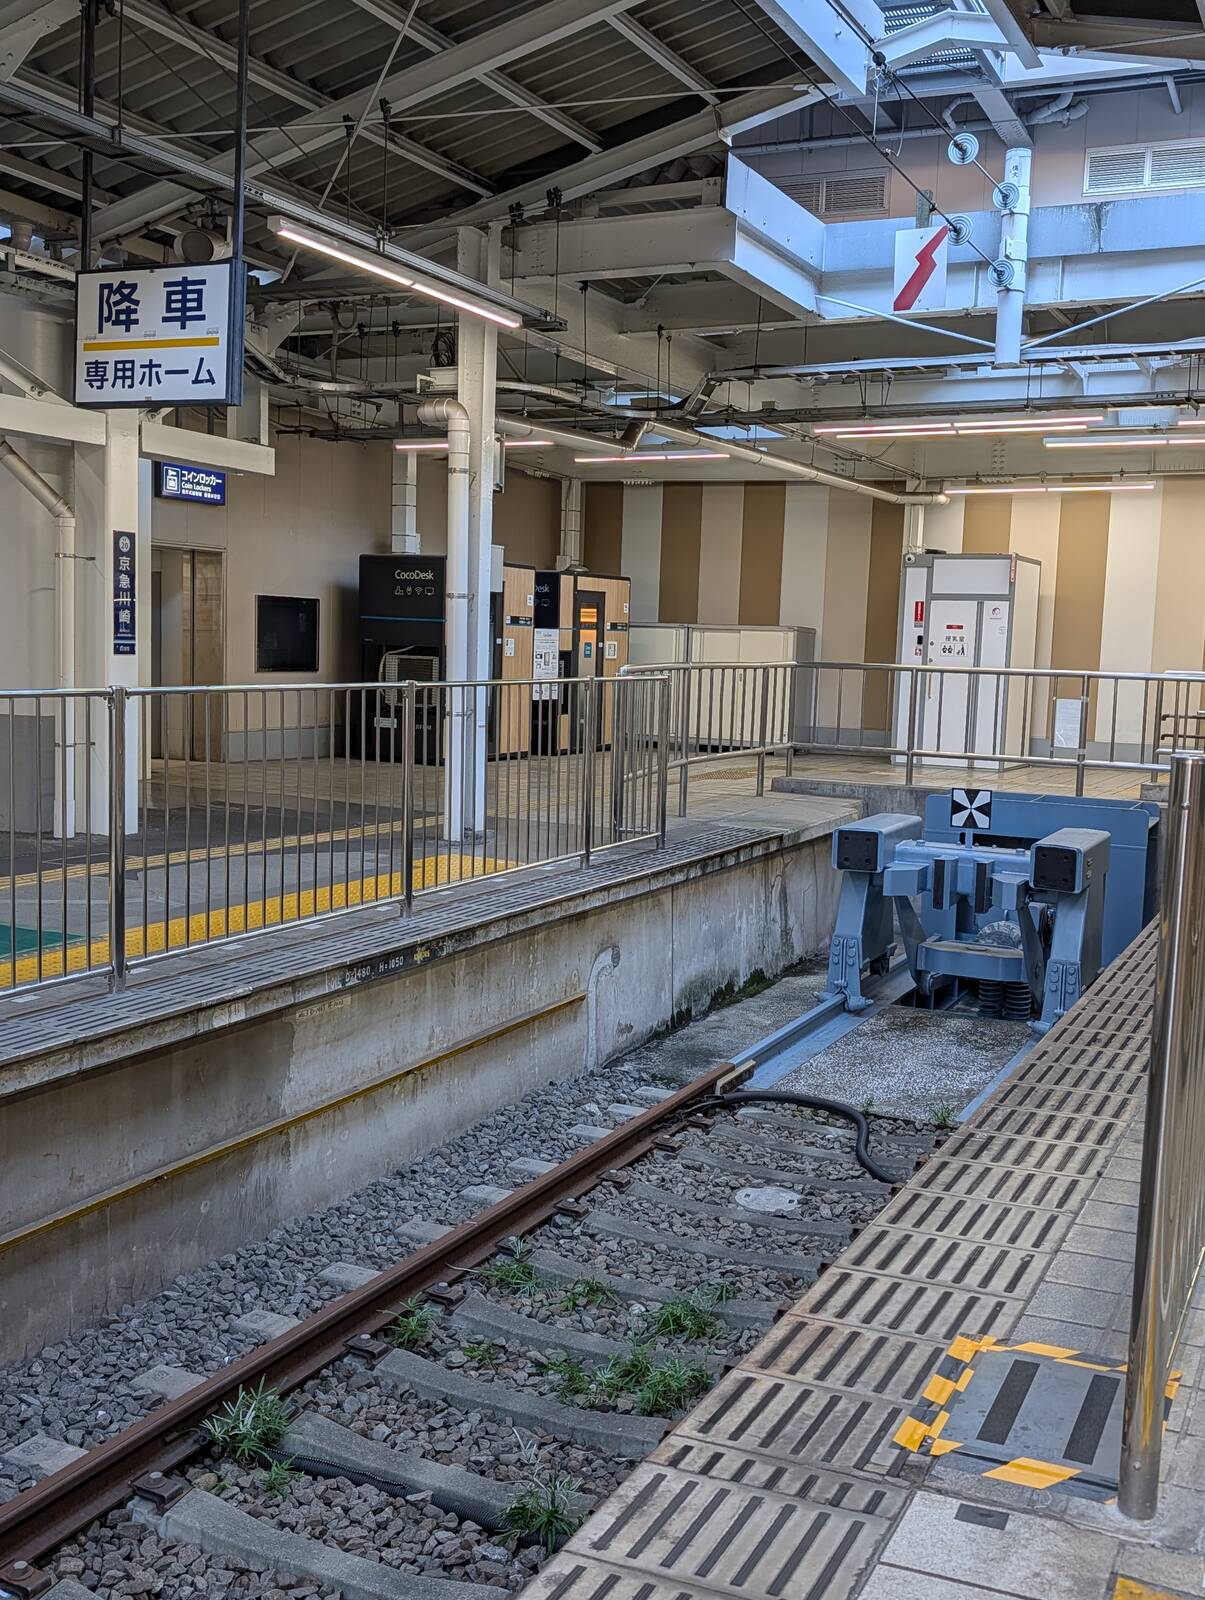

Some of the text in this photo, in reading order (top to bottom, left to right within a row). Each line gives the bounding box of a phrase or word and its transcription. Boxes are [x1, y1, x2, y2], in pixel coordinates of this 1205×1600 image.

[97, 275, 207, 335] 降車
[84, 356, 216, 390] 専用ホーム
[181, 470, 223, 486] コインロッカー
[181, 481, 212, 492] Coin Lockers
[394, 569, 434, 580] CocoDesk
[118, 555, 131, 625] 京急川崎
